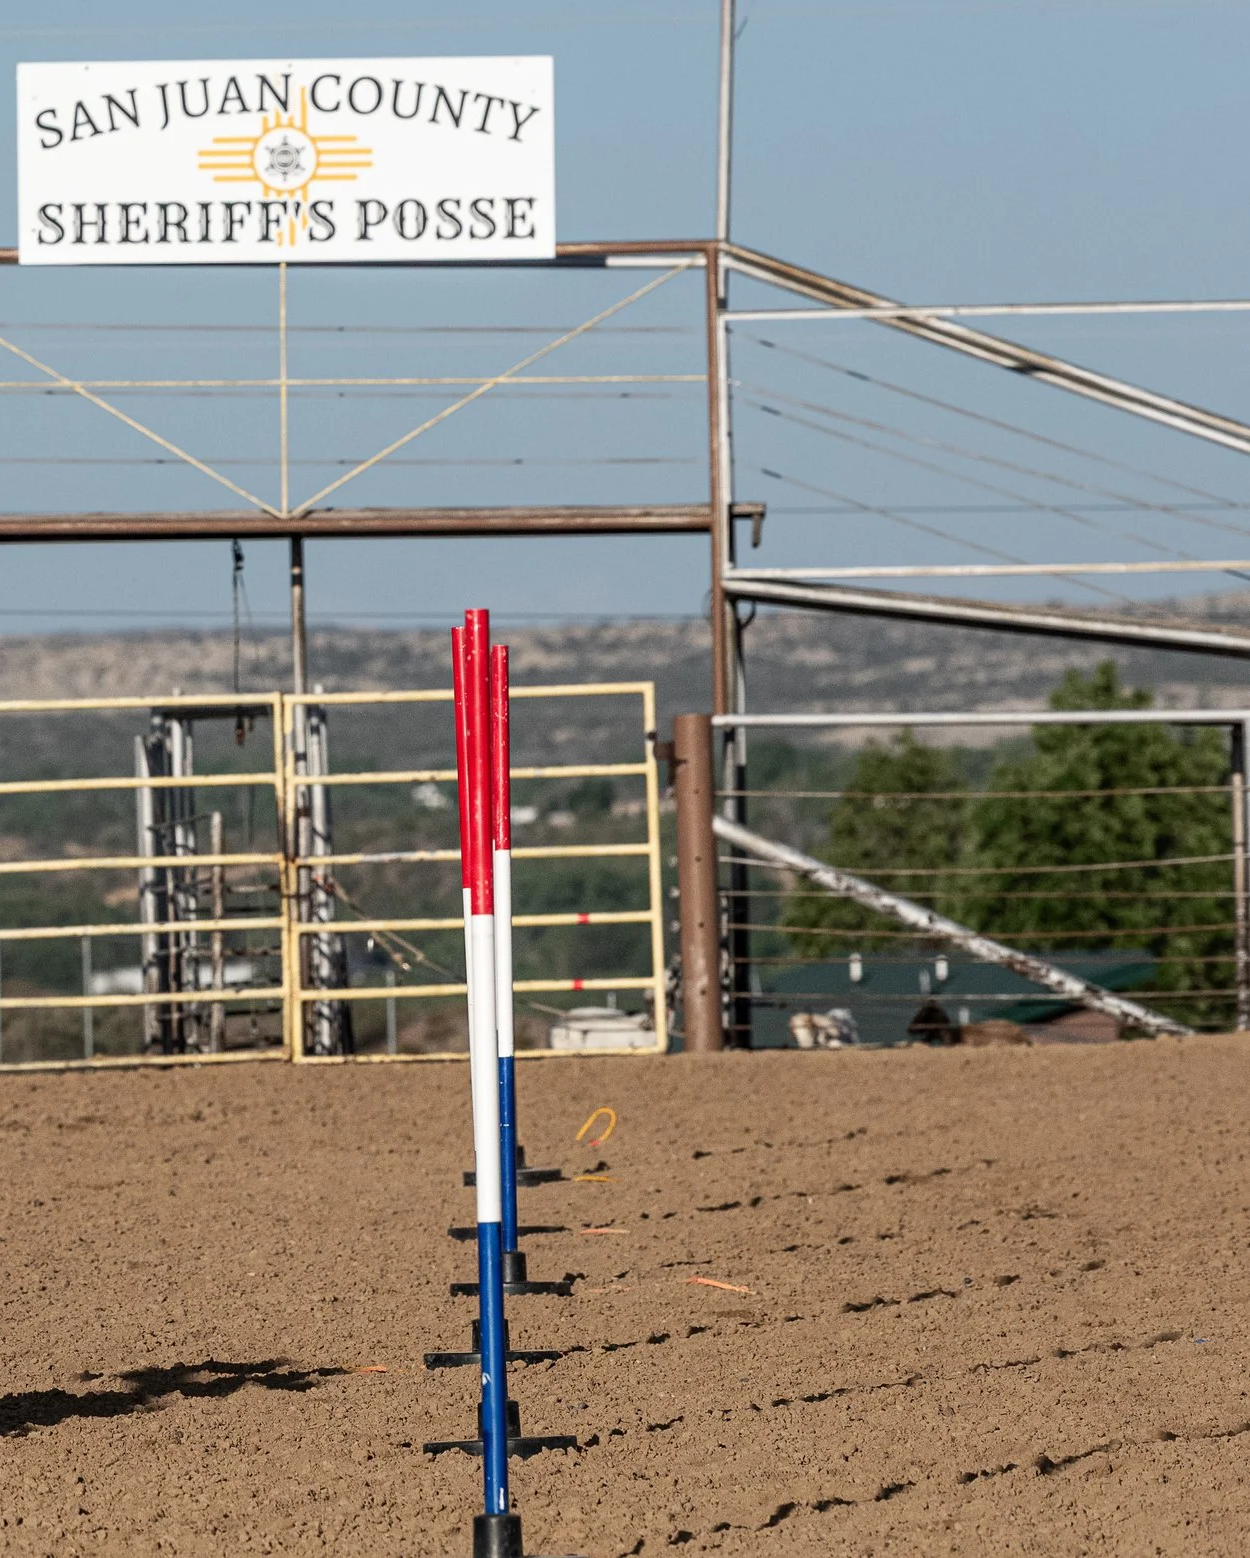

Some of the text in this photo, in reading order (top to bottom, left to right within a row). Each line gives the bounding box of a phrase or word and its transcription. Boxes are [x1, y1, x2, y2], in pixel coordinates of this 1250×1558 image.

[35, 73, 541, 149] SAN JUAN COUNTY
[37, 197, 537, 245] SHERIFF'S POSSE
